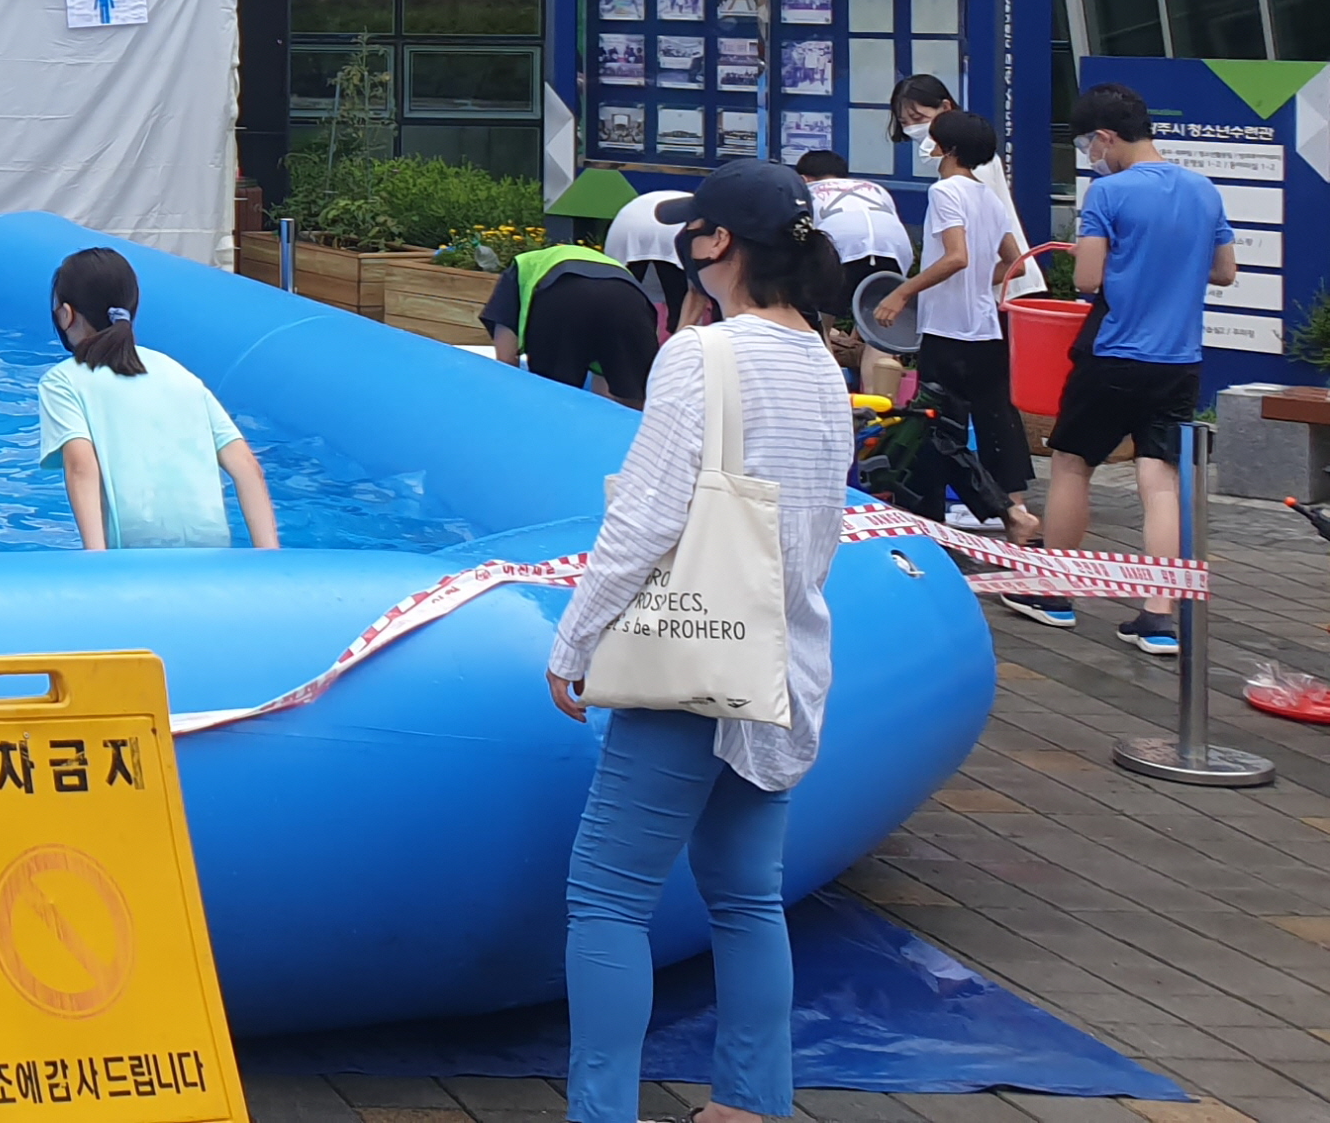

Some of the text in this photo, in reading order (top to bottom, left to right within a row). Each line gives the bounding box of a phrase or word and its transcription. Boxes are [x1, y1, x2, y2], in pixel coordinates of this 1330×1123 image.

[1187, 123, 1275, 140] 청소년수련관
[634, 614, 651, 636] be
[657, 619, 746, 640] PROHERO
[45, 1056, 101, 1104] 감사
[103, 1050, 207, 1098] 드립니다
